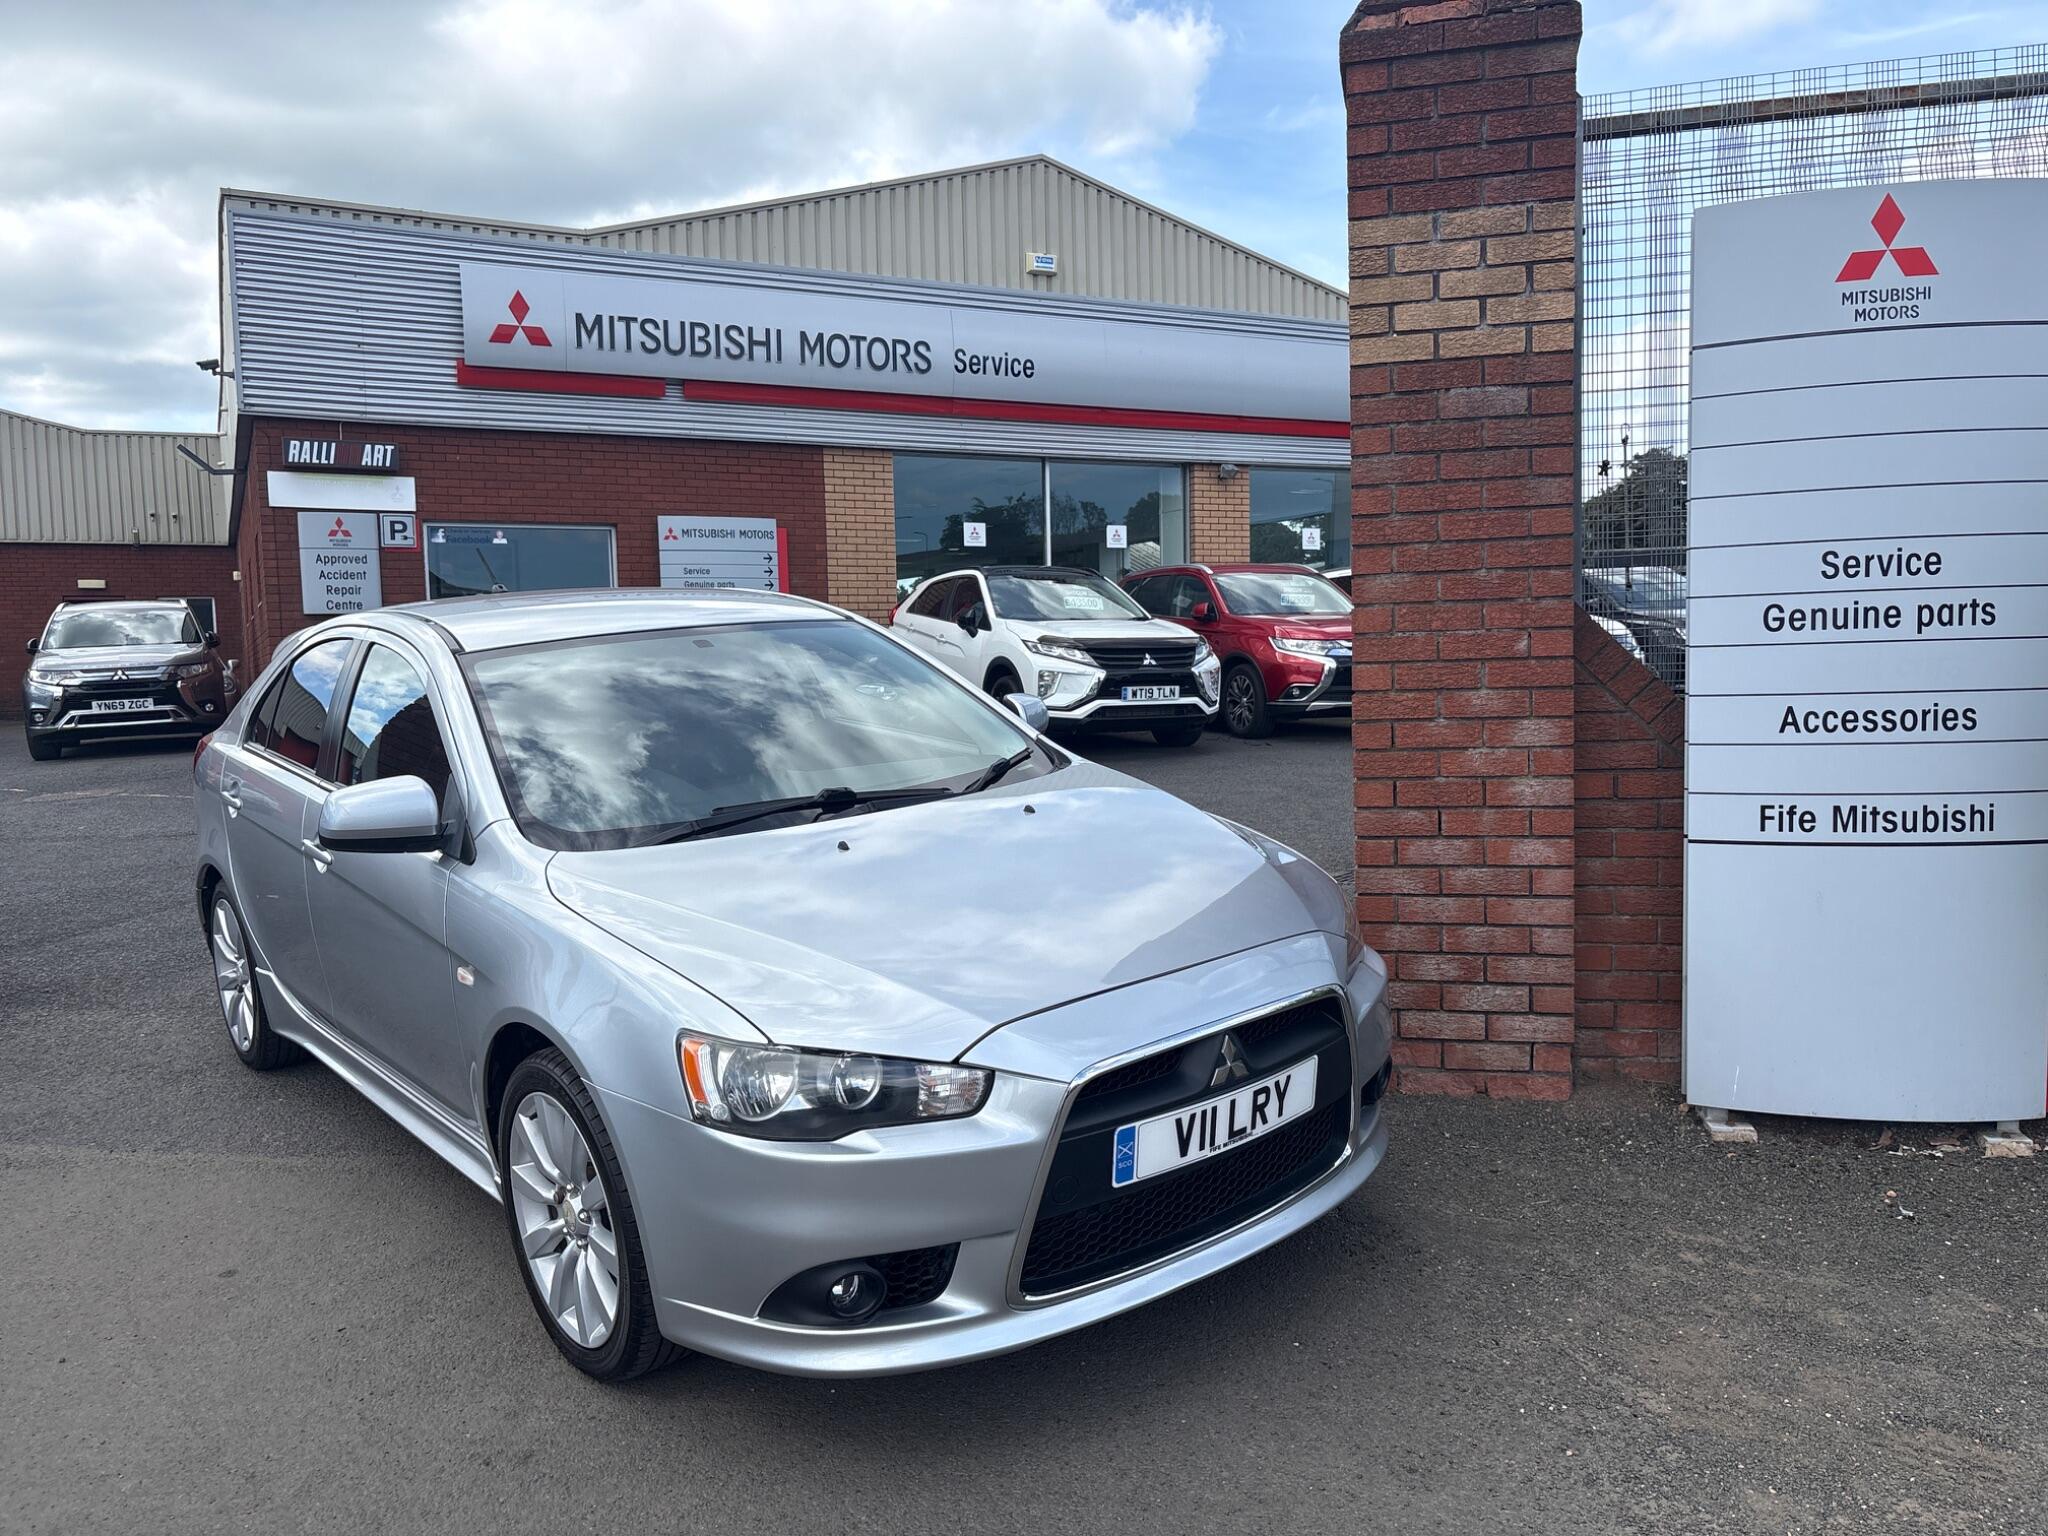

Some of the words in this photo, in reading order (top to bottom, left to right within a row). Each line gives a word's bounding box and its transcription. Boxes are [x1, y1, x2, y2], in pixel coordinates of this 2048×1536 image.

[1842, 286, 1931, 305] MITSUBISHI
[1854, 305, 1920, 322] MOTORS
[574, 312, 783, 364] MITSUBISHI
[799, 330, 932, 375] MOTORS
[953, 348, 1035, 379] Service
[288, 440, 336, 464] RALLI
[361, 444, 394, 467] ART
[389, 520, 408, 541] P
[681, 528, 736, 539] MITSUBISHI
[739, 529, 775, 540] MOTORS
[315, 553, 368, 566] Approved
[1820, 547, 1942, 579] Service
[318, 570, 367, 580] Accident
[683, 567, 711, 575] Service
[326, 584, 362, 597] Repair
[684, 580, 715, 588] Genuine
[326, 600, 364, 610] Centre
[1762, 600, 1902, 632] Genuine
[1916, 598, 1997, 634] parts
[1131, 687, 1154, 699] WT19
[1157, 687, 1176, 698] TLN
[96, 701, 125, 711] YN69
[128, 700, 150, 709] ZGC
[1779, 702, 1978, 734] Accessories
[1759, 804, 1817, 833] Fife
[1832, 803, 1995, 833] Mitsubishi
